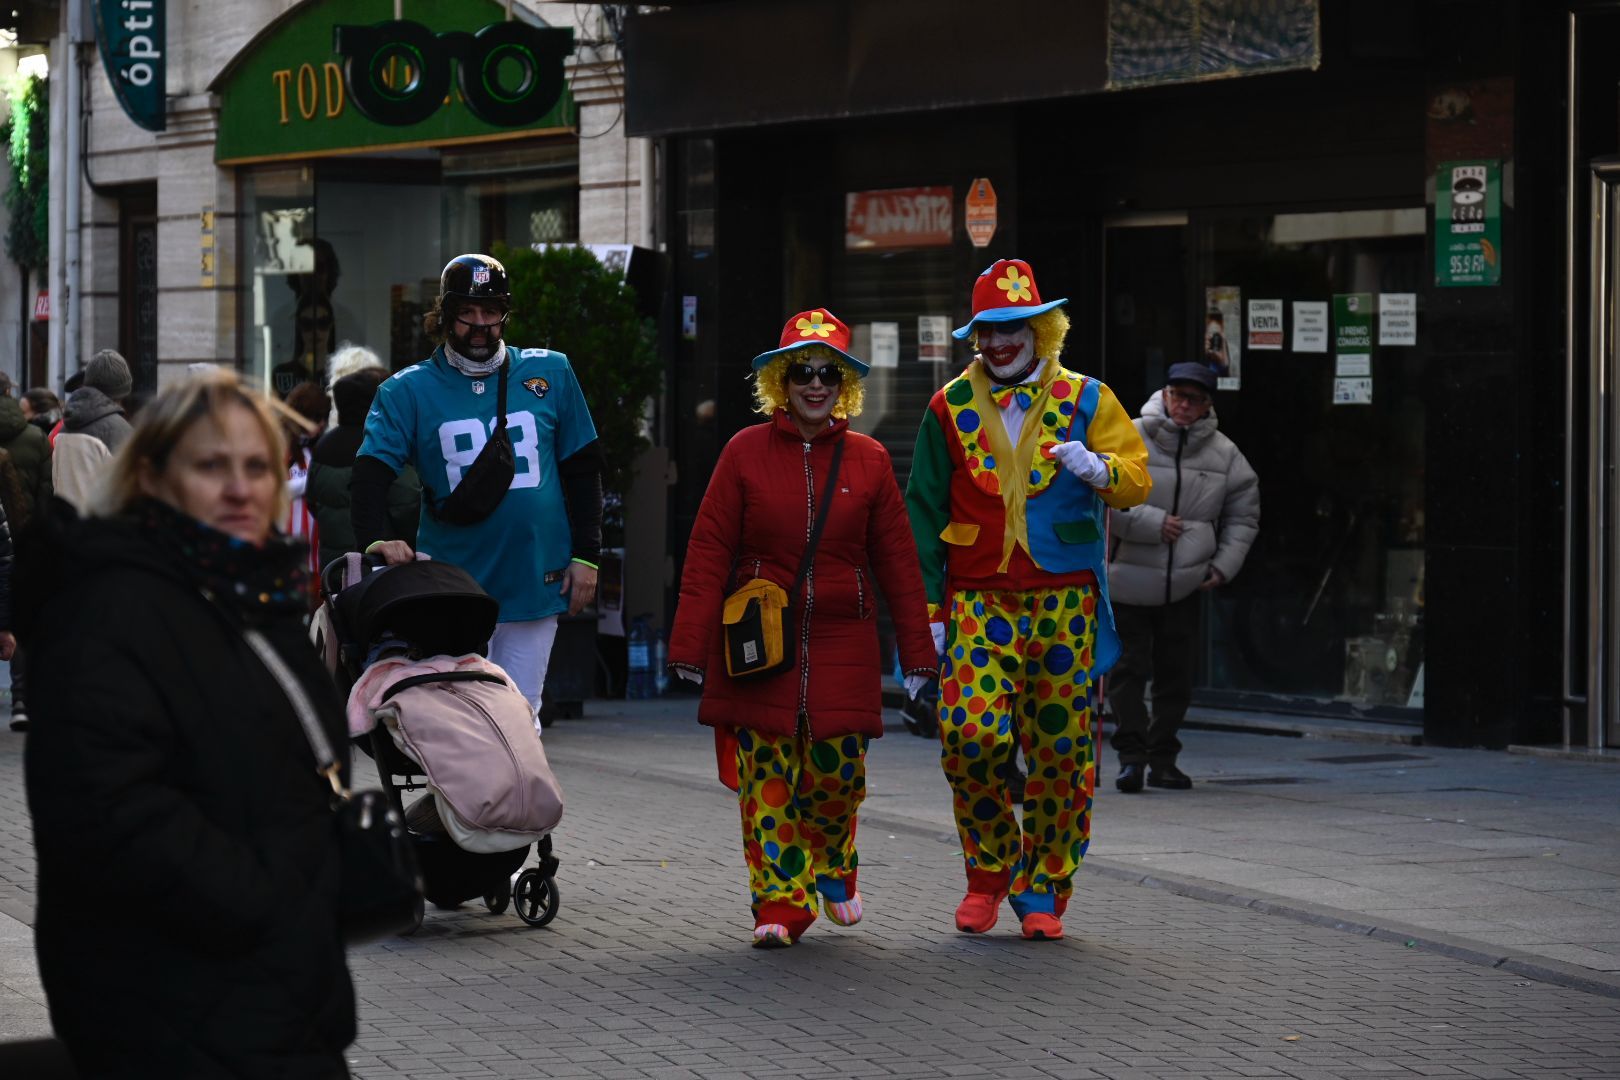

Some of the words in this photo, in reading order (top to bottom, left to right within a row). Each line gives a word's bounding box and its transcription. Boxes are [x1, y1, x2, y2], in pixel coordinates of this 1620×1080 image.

[474, 271, 489, 283] NFL
[1252, 316, 1279, 329] VENTA
[438, 410, 541, 492] 83
